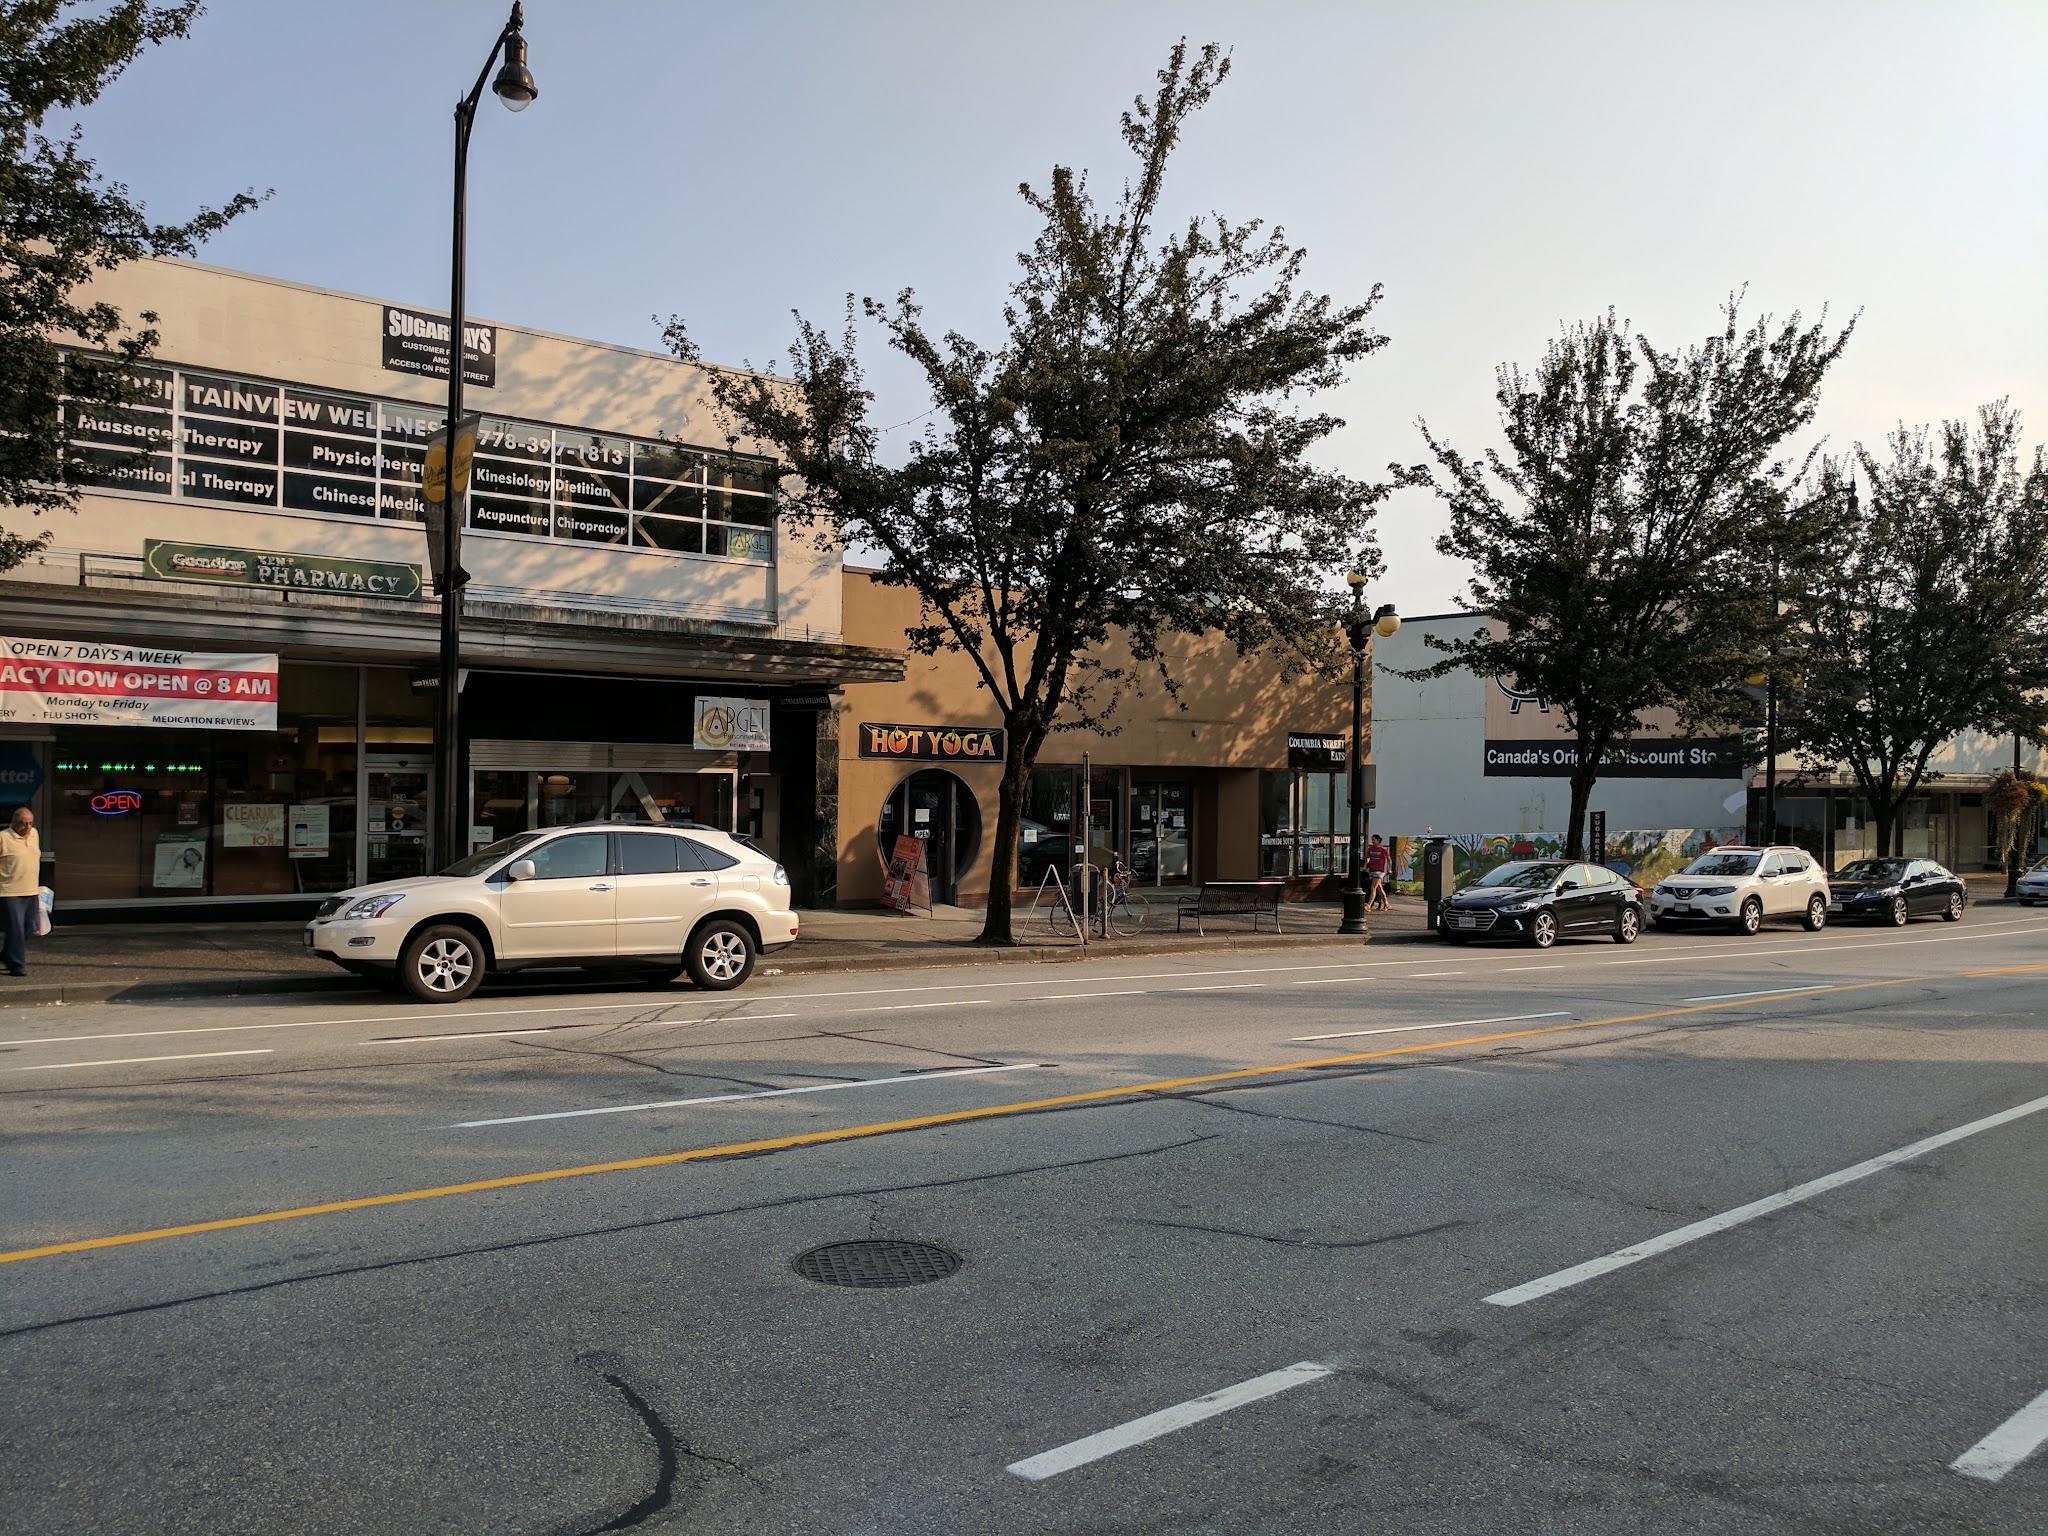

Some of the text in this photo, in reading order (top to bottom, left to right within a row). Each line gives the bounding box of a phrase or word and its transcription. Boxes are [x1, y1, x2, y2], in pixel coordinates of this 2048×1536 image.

[389, 310, 491, 354] SUGARAYS
[402, 341, 445, 355] CUSTOMER
[389, 358, 421, 369] ACCESS
[422, 363, 433, 371] ON
[433, 356, 449, 365] AND
[181, 429, 263, 455] Therapy
[478, 429, 623, 465] 778-397-1813
[202, 473, 275, 498] Therapy
[476, 468, 611, 498] Kinesiology Dietitian
[312, 487, 376, 506] Chinese
[477, 508, 627, 535] Acupuncture Chiropractor
[257, 565, 401, 593] PHARMACY
[11, 642, 183, 665] OPEN 7 DAYS A WEEK
[58, 669, 119, 687] NOW
[123, 672, 188, 692] OPEN
[193, 677, 212, 694] @
[217, 677, 231, 693] 8
[235, 678, 271, 695] AM
[46, 696, 149, 711] Monday to Friday
[43, 711, 61, 719] FLU
[65, 711, 99, 721] SHOTS
[152, 715, 213, 725] MEDICATION
[215, 717, 256, 727] REVIEWS
[698, 700, 767, 732] TARGET
[871, 729, 995, 756] HOT YOGA
[1289, 737, 1345, 749] COLUMBIA STREET
[1331, 751, 1345, 761] EATS
[1487, 749, 1550, 765] Canada's
[91, 795, 140, 810] OPEN
[915, 829, 929, 838] OPEN
